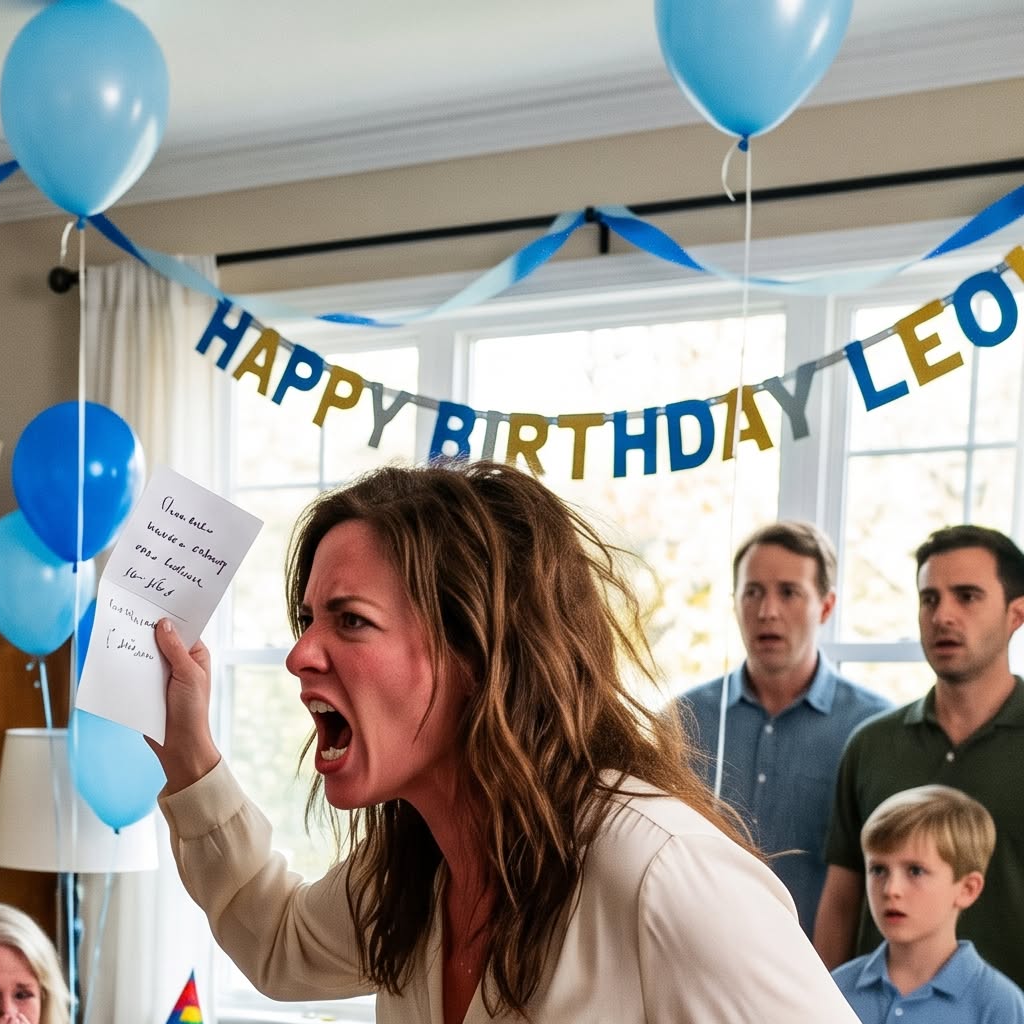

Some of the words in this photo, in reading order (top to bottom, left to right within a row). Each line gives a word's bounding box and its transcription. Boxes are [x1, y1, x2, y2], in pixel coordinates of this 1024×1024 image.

[195, 297, 414, 449] HAPPY
[429, 361, 817, 480] BIRTHDAY
[844, 245, 1024, 412] LEO
